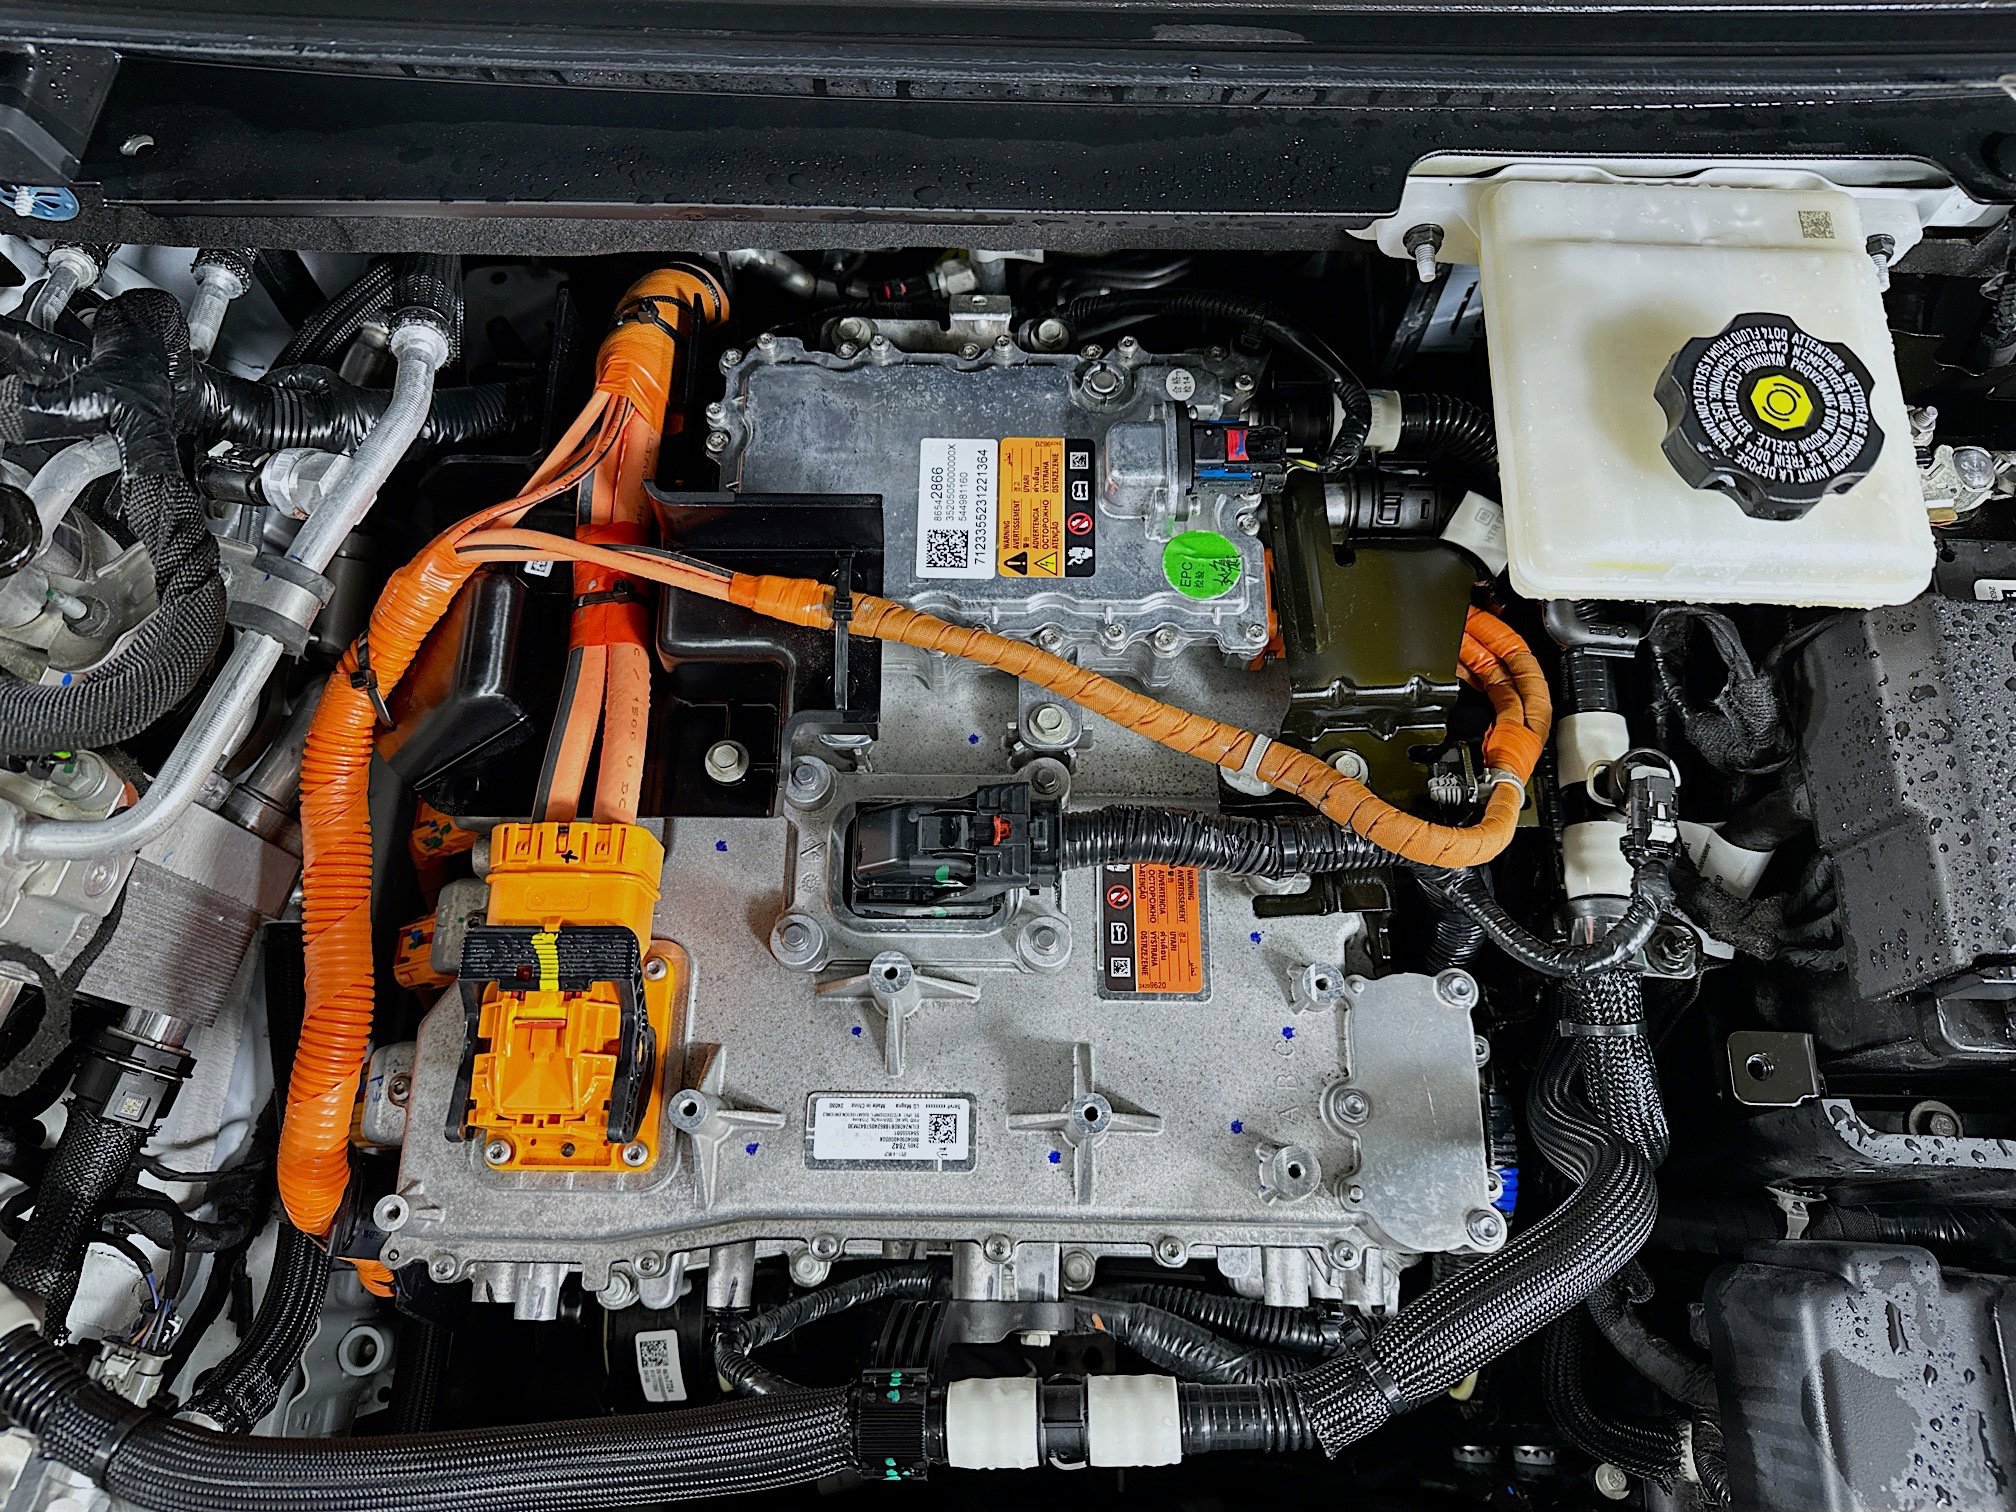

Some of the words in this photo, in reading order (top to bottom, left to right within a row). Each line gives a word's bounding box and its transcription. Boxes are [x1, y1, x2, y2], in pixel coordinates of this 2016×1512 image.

[1730, 327, 1760, 344] FLUID
[1761, 327, 1788, 341] DOT4
[1769, 340, 1788, 354] CAP
[1701, 355, 1715, 366] A
[1706, 336, 1734, 361] FROM
[1729, 340, 1768, 361] BEFORE
[1791, 332, 1845, 373] ATTENTION:
[1693, 362, 1711, 398] SEALED
[1724, 371, 1743, 401] CLEAN
[1790, 357, 1838, 408] PROVENANT
[1837, 392, 1854, 413] QUE
[1842, 371, 1869, 422] NETTOYER
[1710, 402, 1728, 423] USE
[1725, 402, 1754, 437] FILLER
[1821, 408, 1838, 433] D'UN
[1839, 413, 1854, 430] DU
[1720, 421, 1745, 446] ONLY
[1798, 428, 1830, 453] BIDON
[1854, 421, 1868, 436] LE
[1744, 441, 1771, 463] DOT4
[1819, 427, 1850, 460] LIQUIDE
[1827, 434, 1865, 474] BOUCHON
[1774, 453, 1806, 470] FREIN
[1806, 451, 1823, 467] DE
[1041, 461, 1049, 492] VÝSTRAHA
[1779, 467, 1794, 484] LA
[1798, 463, 1830, 483] AVANT
[931, 466, 943, 521] 86542866
[959, 472, 968, 521] 544981160
[975, 449, 988, 565] 7123355231221364
[1003, 521, 1011, 549] WARNING
[1051, 522, 1060, 549] ATENÇÃO
[1180, 561, 1193, 587] EPC
[1138, 870, 1148, 899] ATENÇÃO
[1148, 870, 1156, 923] ОСТОРОЖНО
[1158, 870, 1166, 914] ADVERTENCIA
[1177, 870, 1185, 922] AVERTISSEMENT
[1150, 931, 1158, 966] VÝSTRAHA
